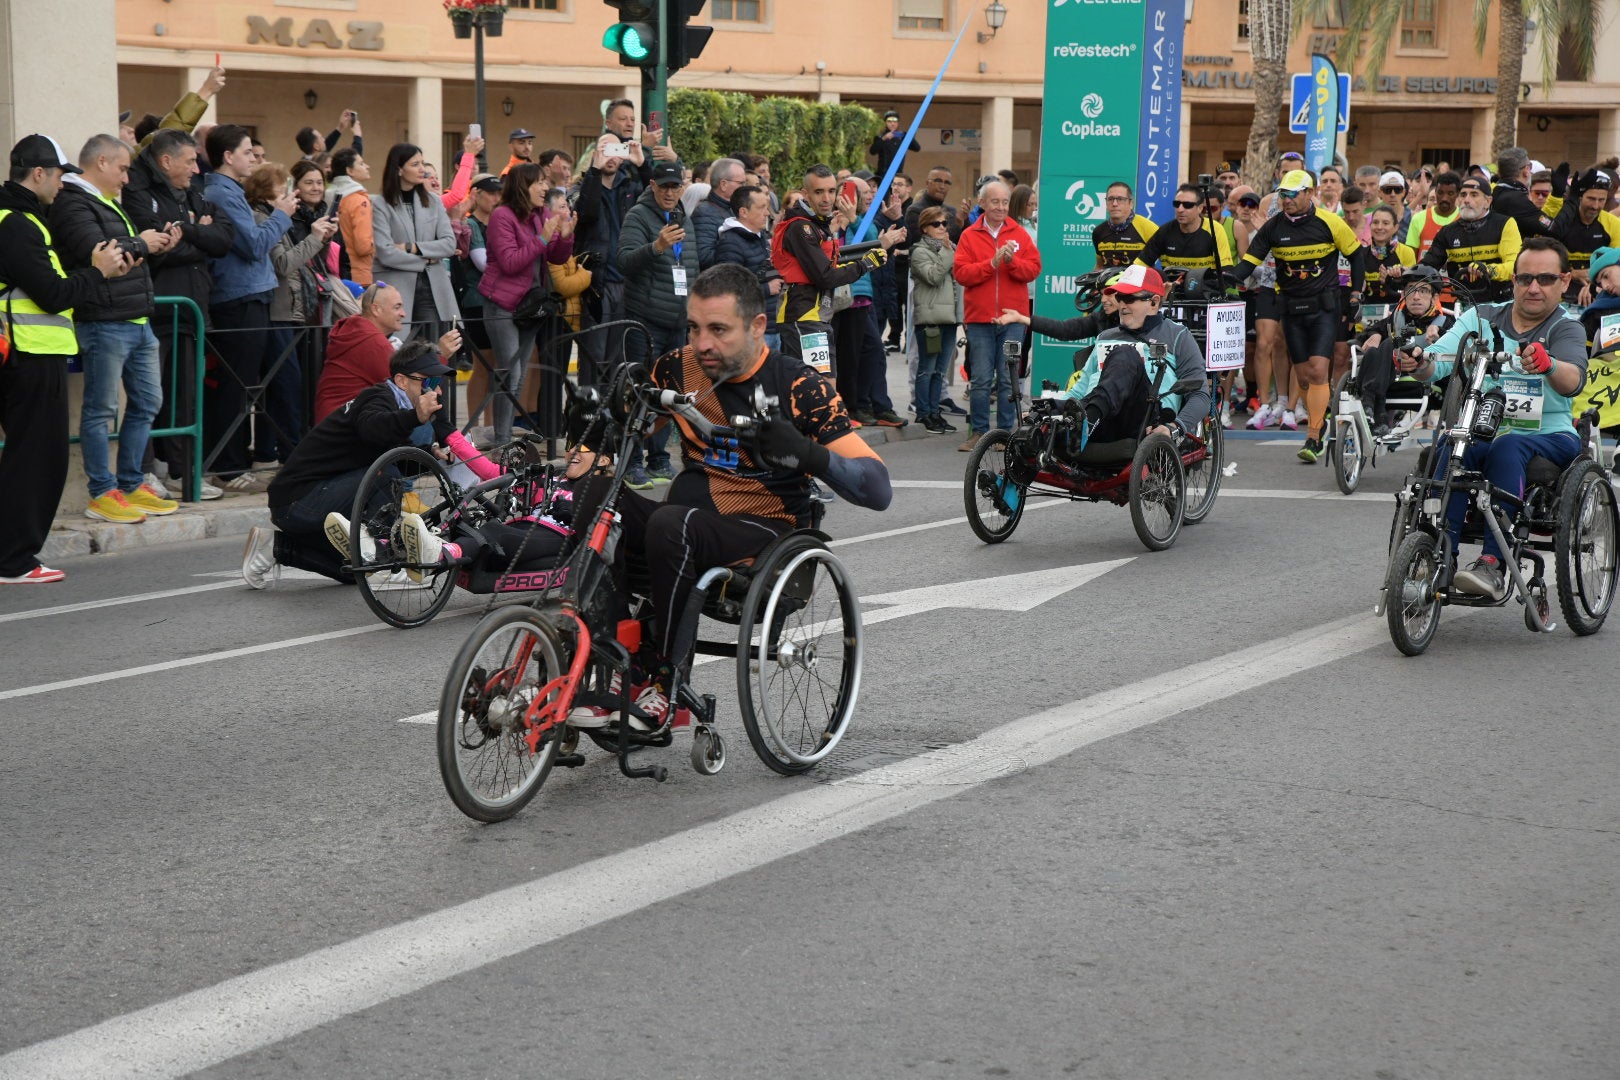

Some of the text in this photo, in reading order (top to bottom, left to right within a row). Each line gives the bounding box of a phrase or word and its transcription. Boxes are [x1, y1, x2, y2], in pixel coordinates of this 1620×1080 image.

[246, 15, 384, 50] MAZ
[1406, 77, 1498, 93] SEGUROS
[1062, 121, 1121, 139] Coplaca
[1162, 148, 1171, 198] CLUB
[1211, 353, 1222, 363] CON
[1506, 398, 1533, 413] 34
